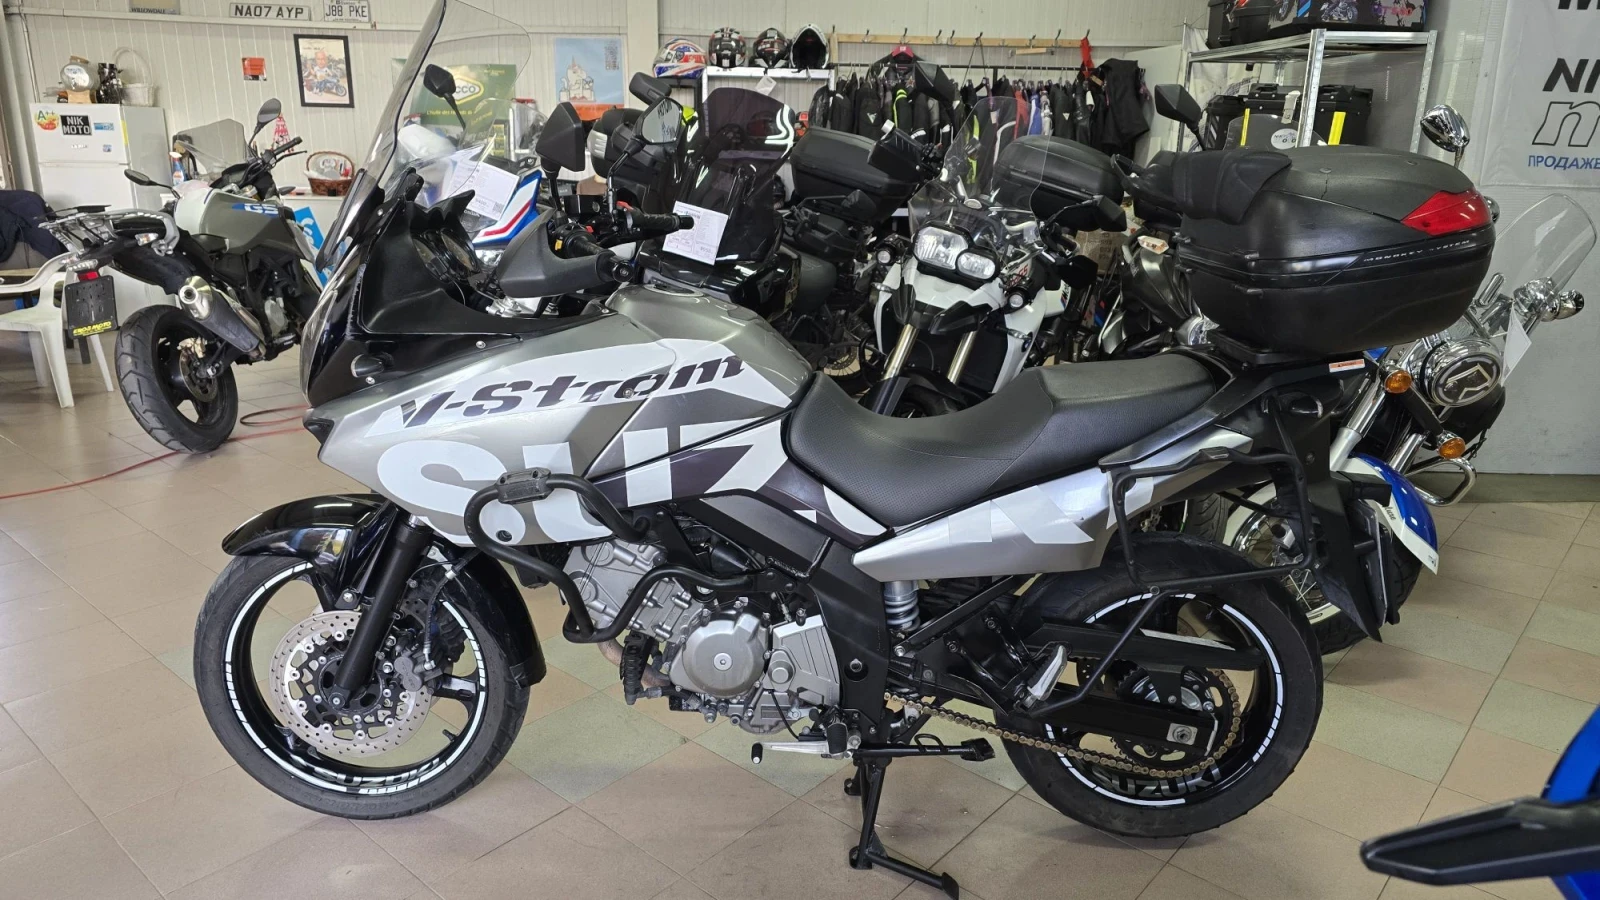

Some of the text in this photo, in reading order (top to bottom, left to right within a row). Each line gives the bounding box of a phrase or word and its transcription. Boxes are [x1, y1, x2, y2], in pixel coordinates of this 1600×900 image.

[234, 5, 304, 18] NA07 AYP
[349, 5, 367, 17] PKE
[66, 116, 84, 125] NIK
[63, 125, 91, 134] MOTO
[400, 354, 747, 428] V-Strom
